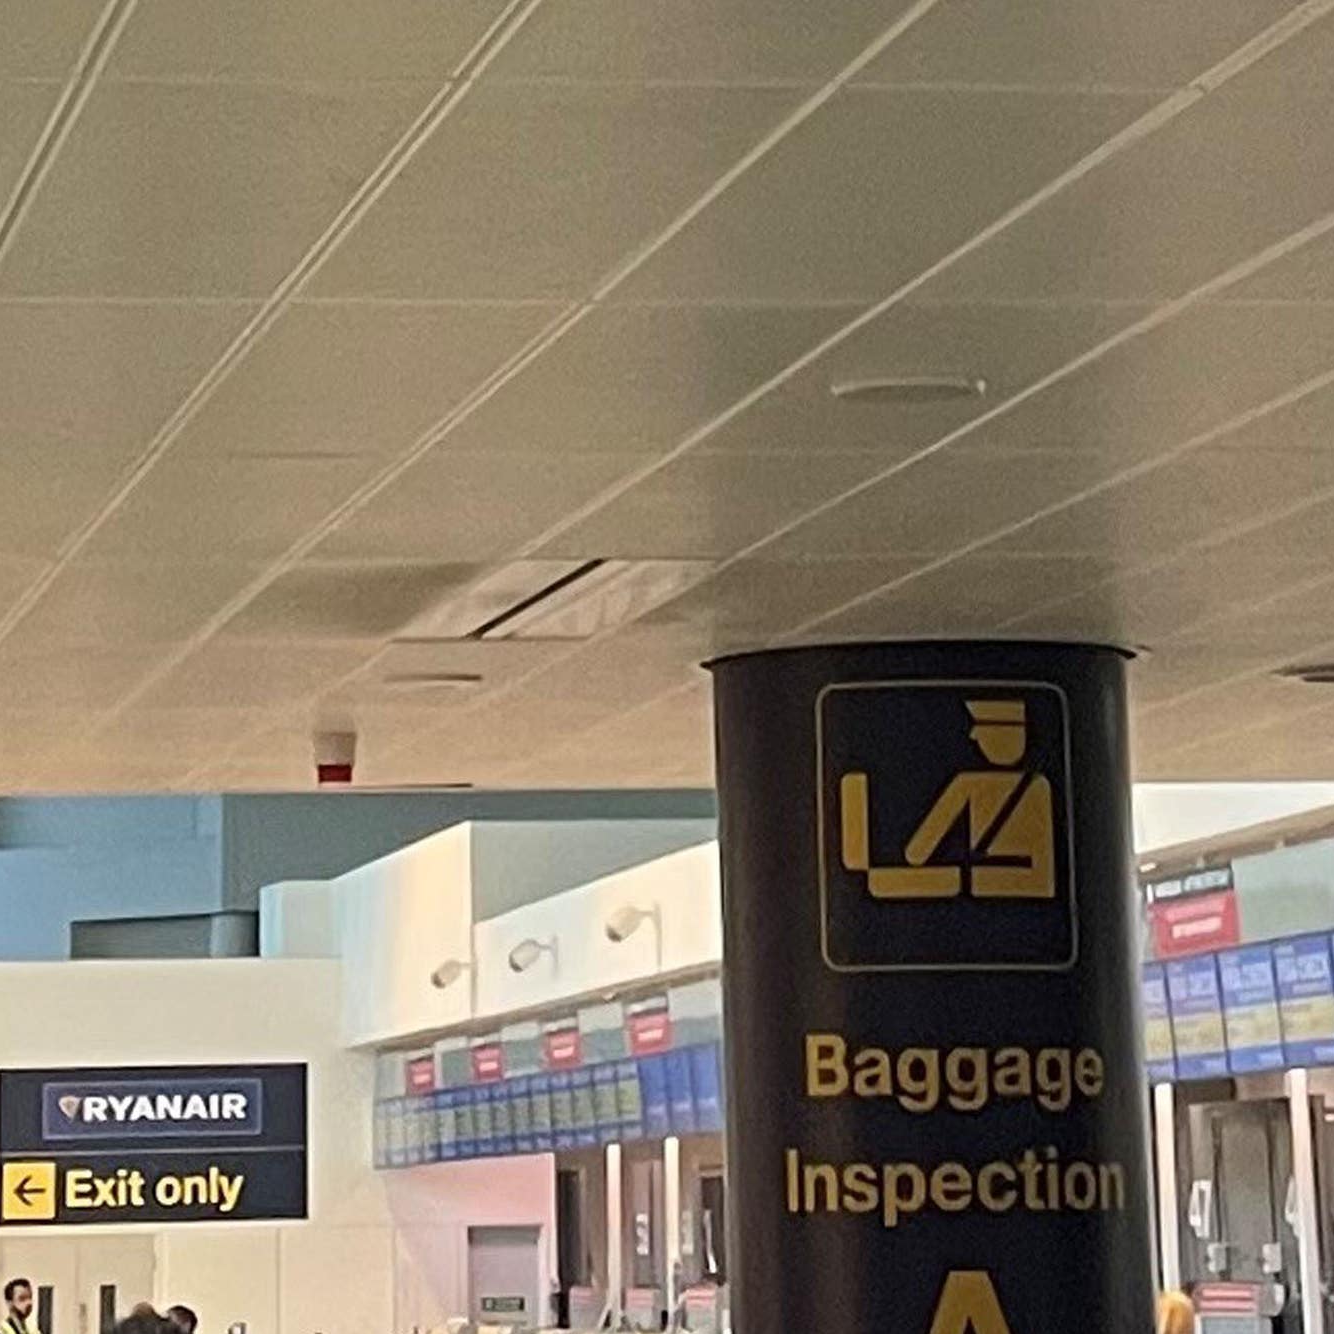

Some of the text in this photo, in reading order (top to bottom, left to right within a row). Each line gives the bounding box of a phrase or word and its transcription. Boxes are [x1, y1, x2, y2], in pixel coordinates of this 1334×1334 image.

[805, 1033, 1105, 1112] Baggage
[81, 1091, 248, 1123] RYANAIR
[64, 1166, 246, 1214] Exit only
[786, 1148, 1126, 1228] Inspection
[1188, 1179, 1212, 1239] 47
